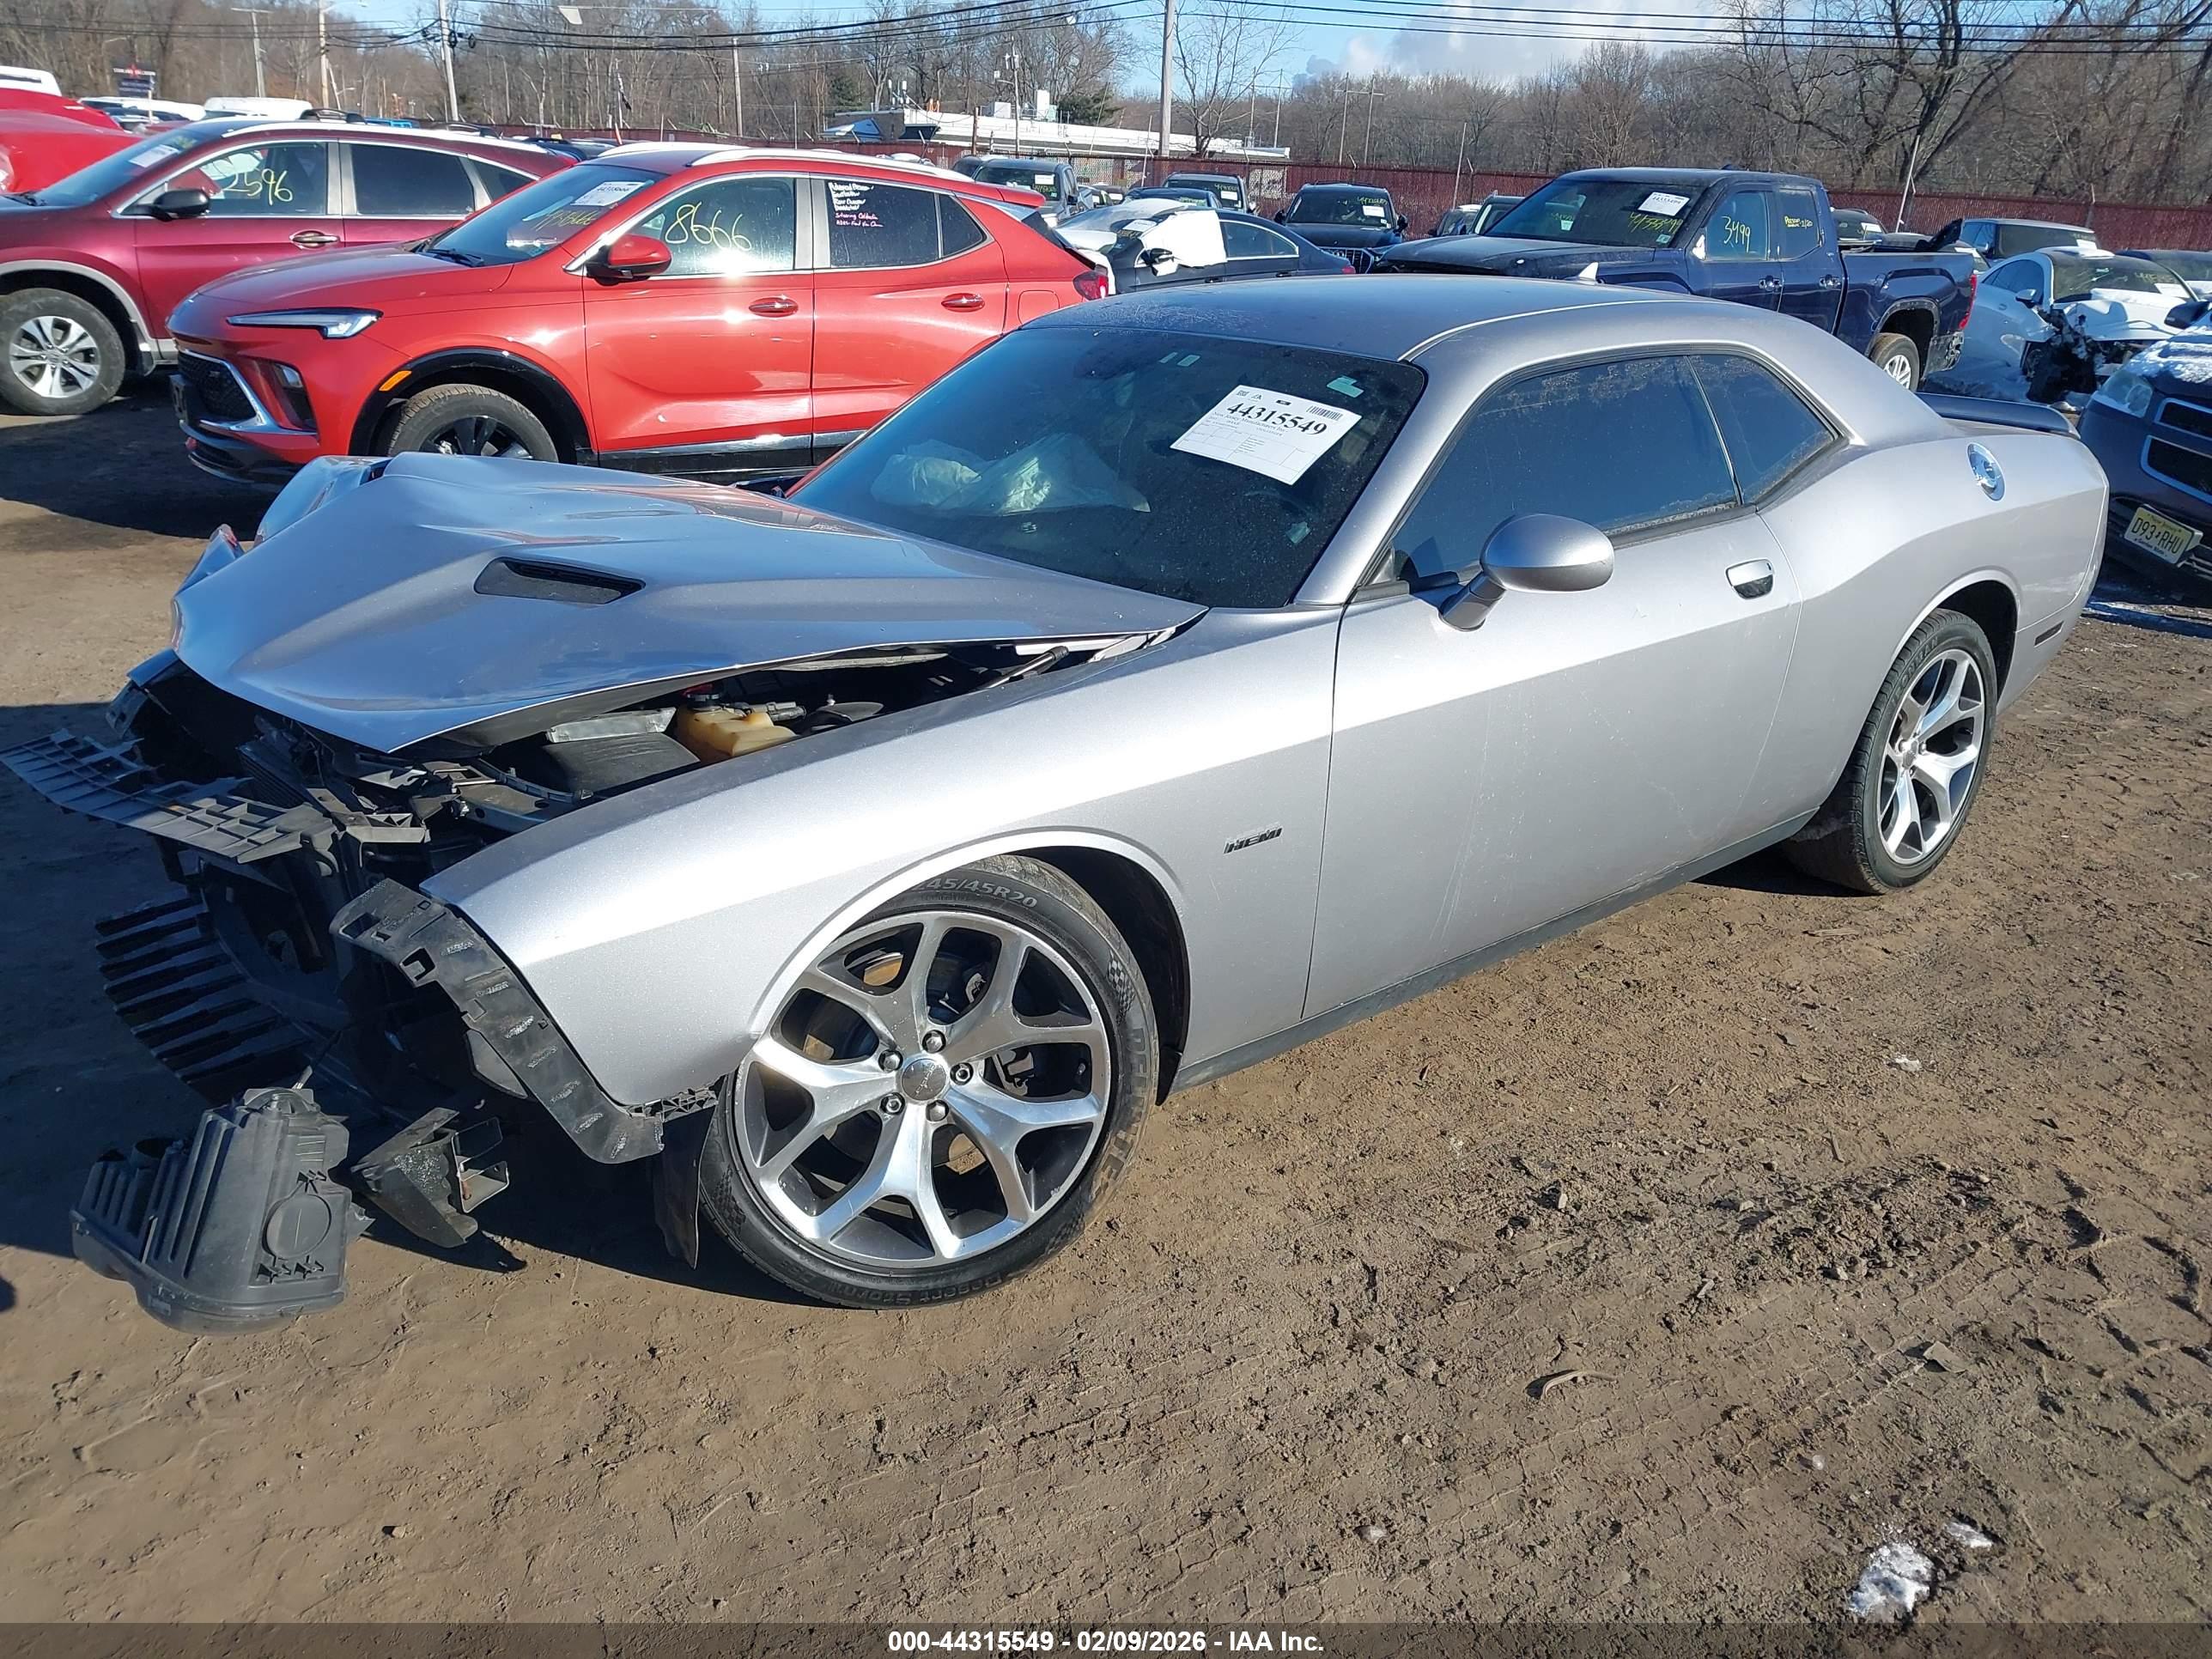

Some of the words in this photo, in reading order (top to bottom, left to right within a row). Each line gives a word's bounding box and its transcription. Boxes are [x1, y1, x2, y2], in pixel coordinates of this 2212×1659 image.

[223, 168, 293, 206] 2596
[665, 201, 752, 251] 8666
[1722, 216, 1751, 253] 3499
[1227, 403, 1328, 434] 44315549
[1224, 828, 1283, 854] HEMI
